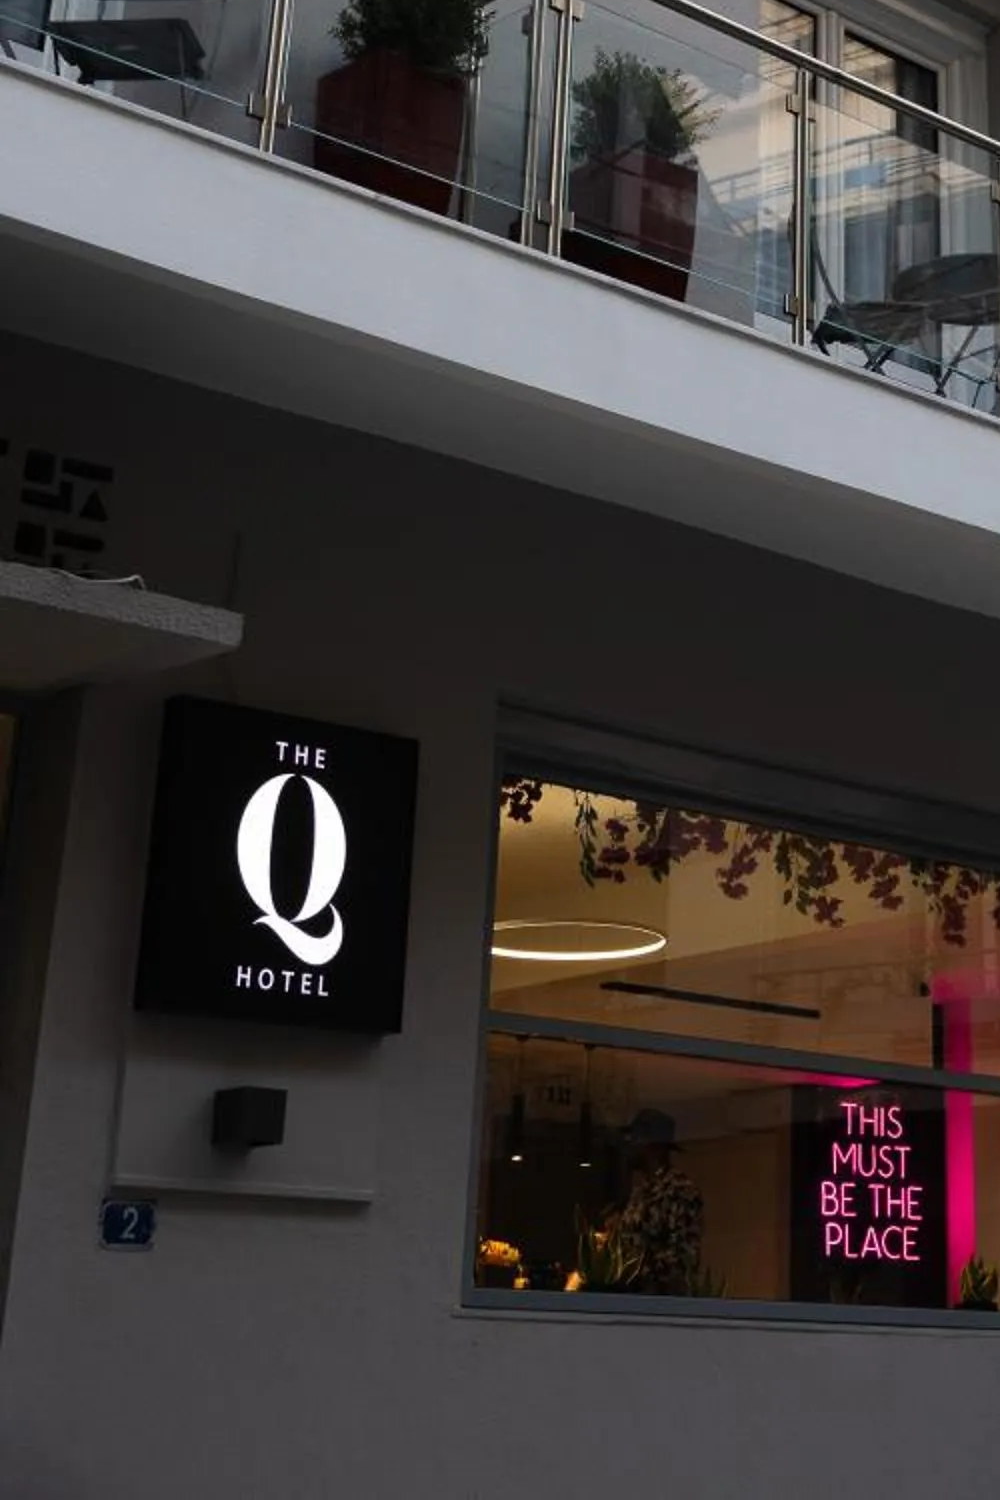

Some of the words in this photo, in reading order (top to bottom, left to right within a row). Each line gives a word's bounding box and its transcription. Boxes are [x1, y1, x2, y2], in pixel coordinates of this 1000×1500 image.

[275, 741, 328, 769] THE
[237, 773, 347, 965] Q
[236, 965, 329, 997] HOTEL
[839, 1102, 903, 1139] THIS
[831, 1142, 911, 1180] MUST
[820, 1181, 858, 1217] BE
[868, 1183, 924, 1221] THE
[121, 1206, 139, 1239] 2
[825, 1222, 921, 1261] PLACE
